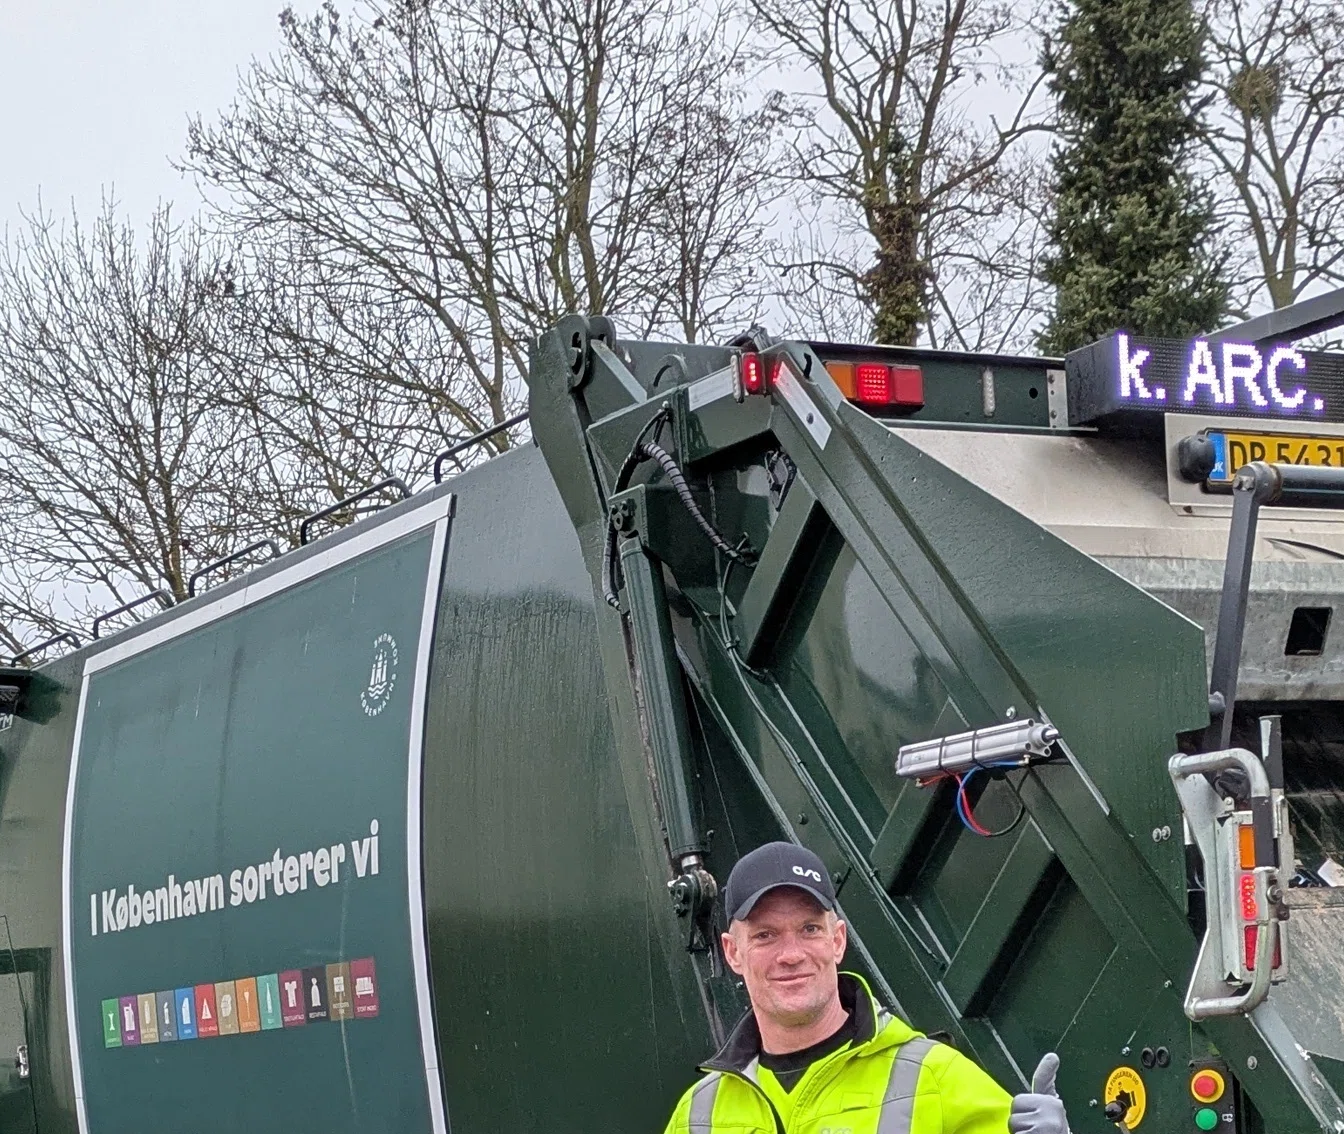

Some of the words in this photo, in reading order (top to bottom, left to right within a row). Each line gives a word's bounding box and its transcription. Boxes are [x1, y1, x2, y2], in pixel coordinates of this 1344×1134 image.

[1116, 332, 1166, 400] k.
[1183, 340, 1325, 412] ARC.
[90, 893, 98, 936] I
[102, 873, 225, 933] København
[229, 843, 346, 906] sorterer
[352, 818, 379, 878] vi
